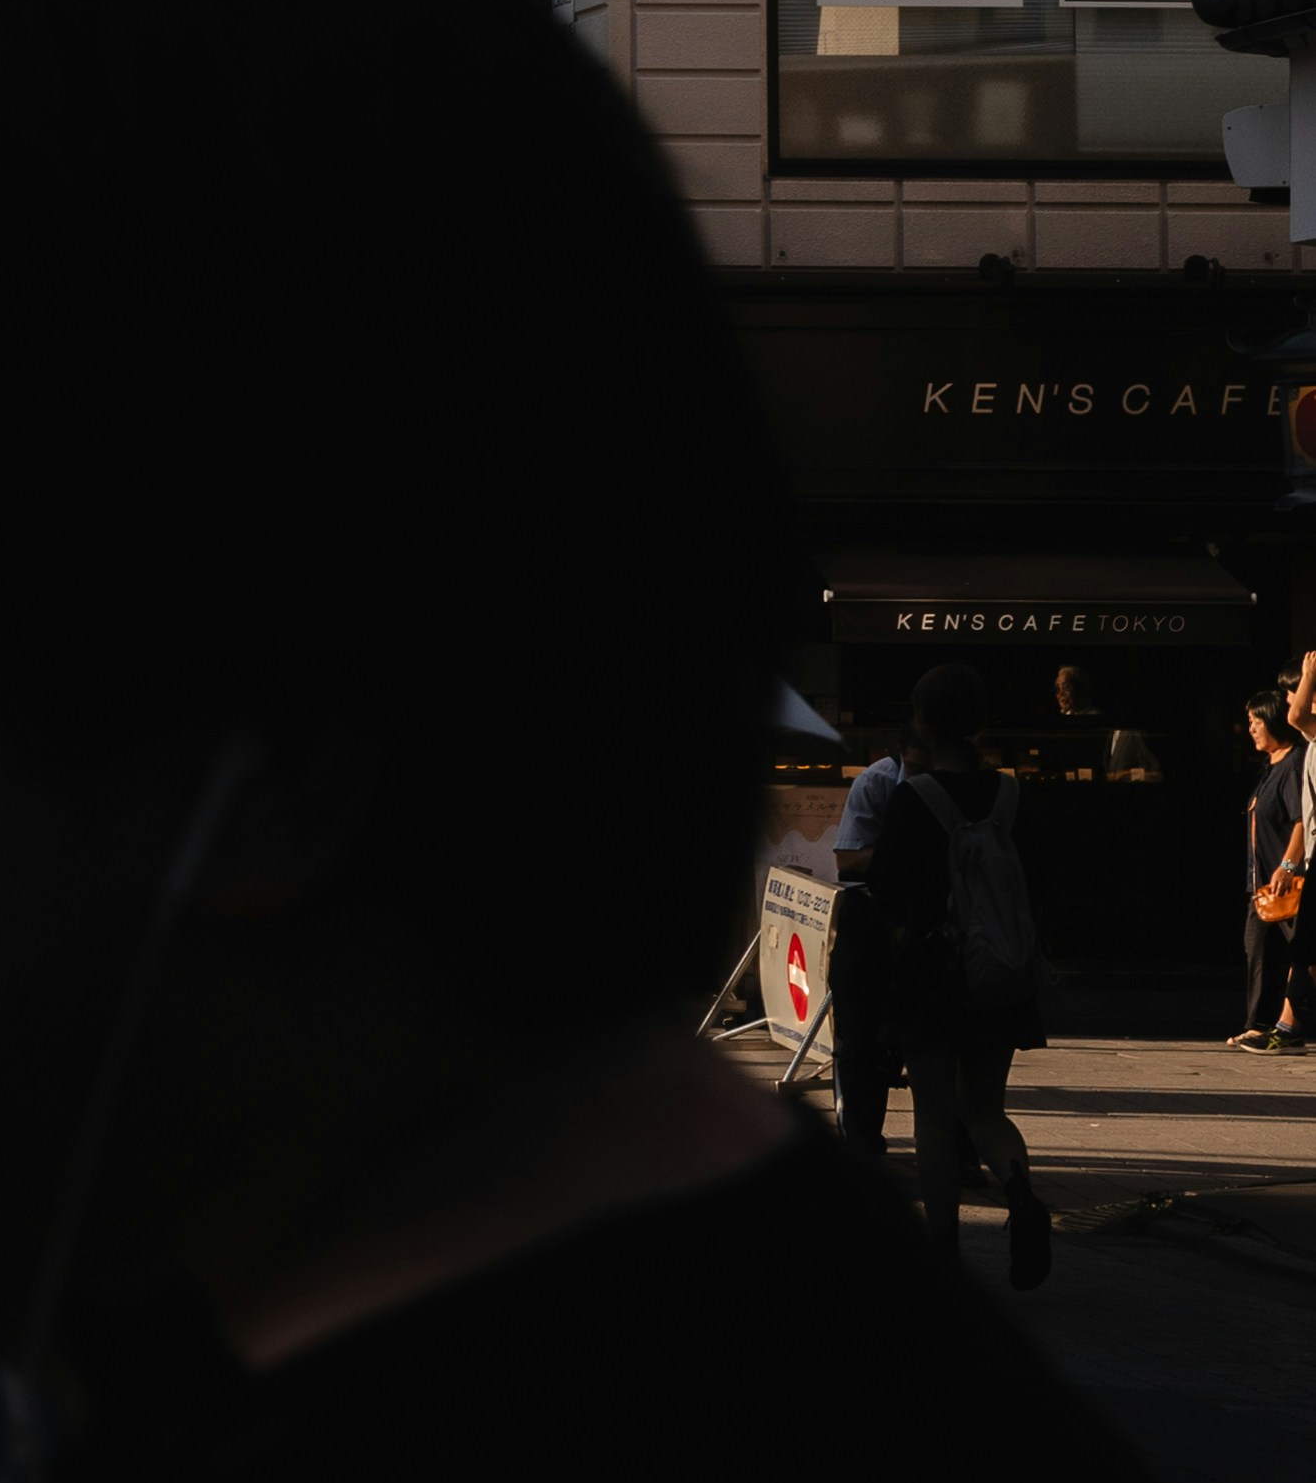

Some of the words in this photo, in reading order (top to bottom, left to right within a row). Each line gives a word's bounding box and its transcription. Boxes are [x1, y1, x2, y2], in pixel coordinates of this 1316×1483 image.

[923, 382, 1095, 415] KEN'S
[896, 613, 985, 632] KEN'S
[998, 613, 1087, 632] CAFE
[1097, 614, 1186, 633] TOKYO
